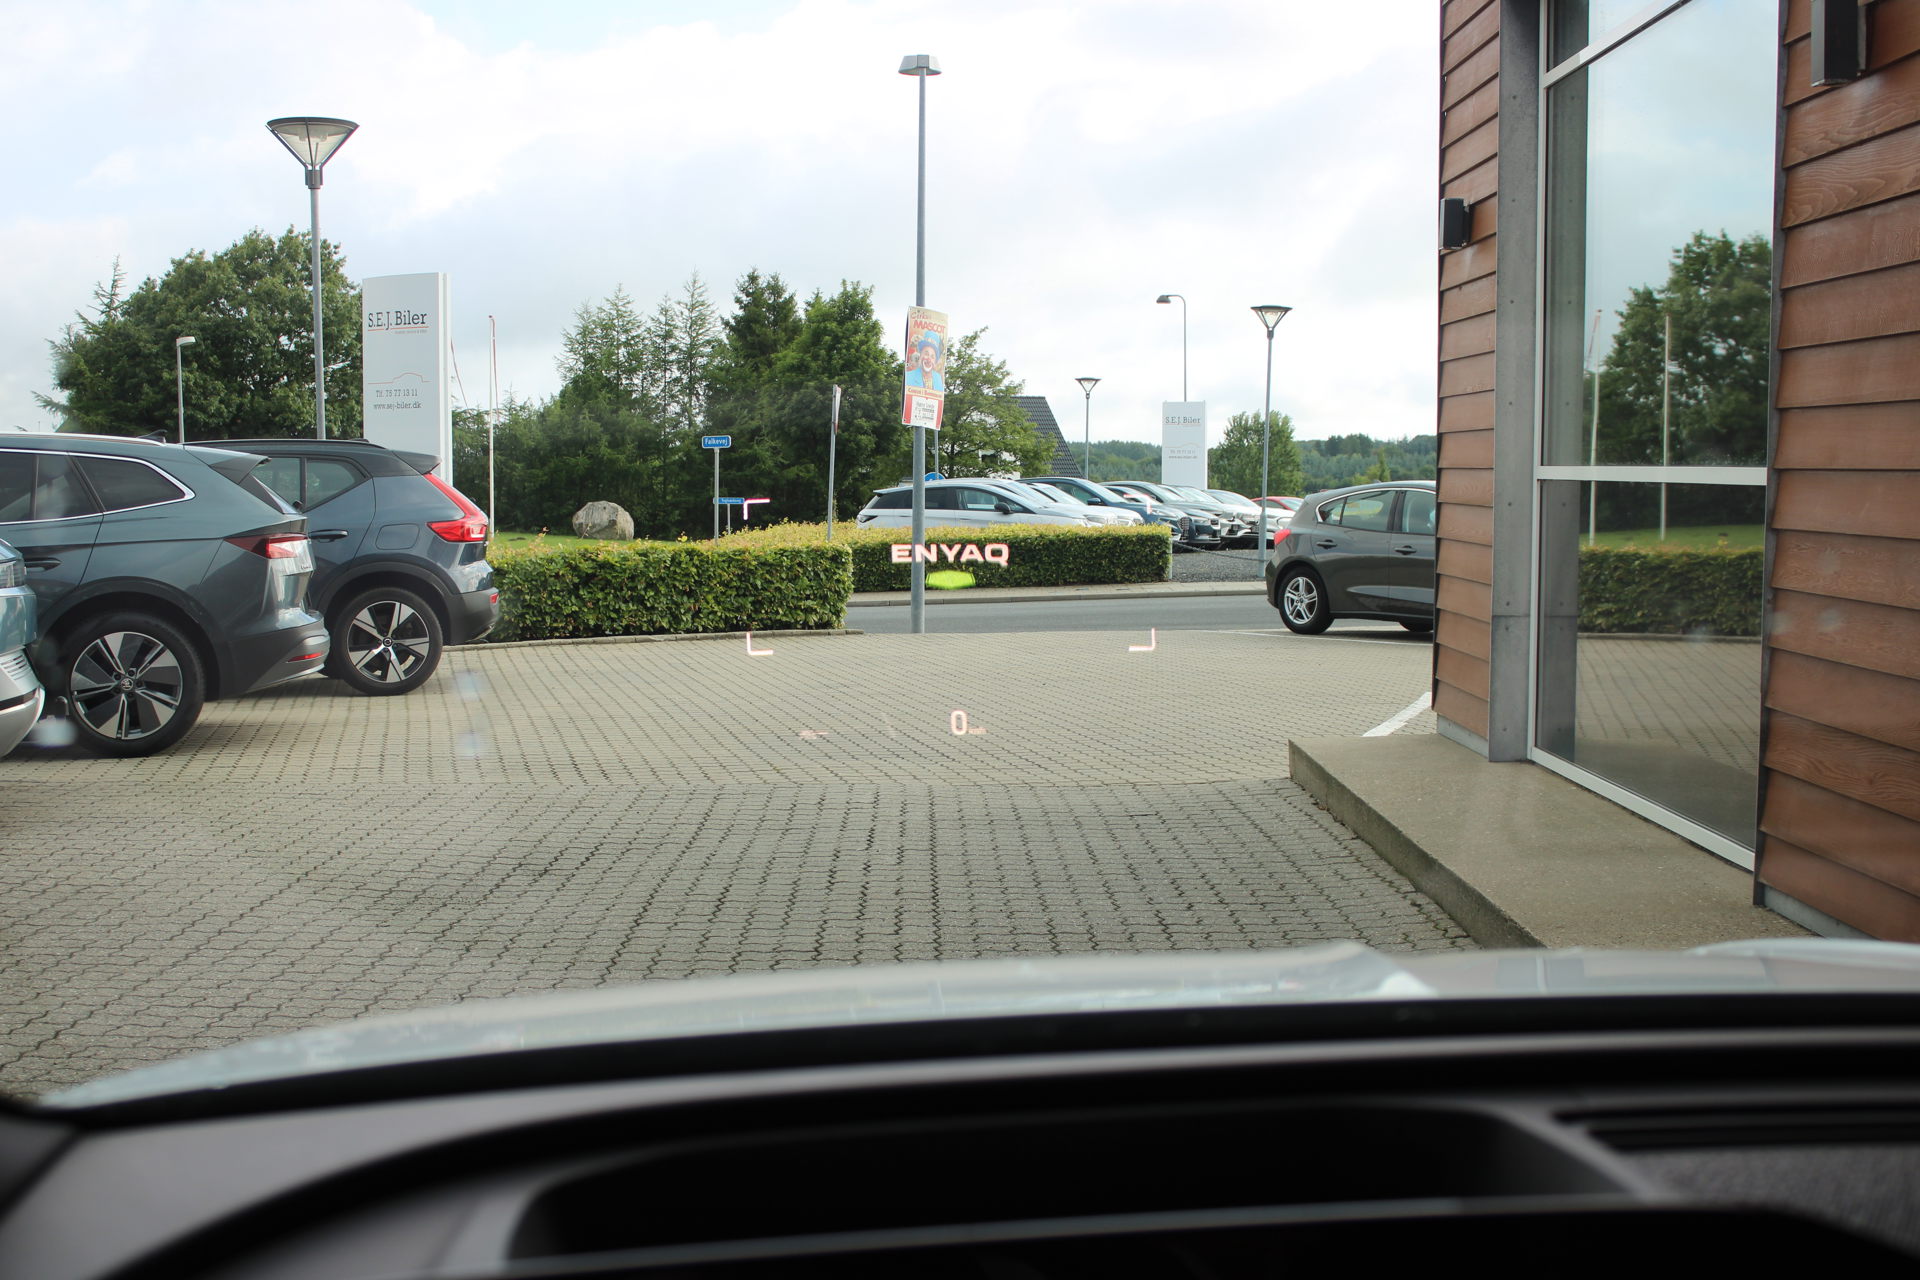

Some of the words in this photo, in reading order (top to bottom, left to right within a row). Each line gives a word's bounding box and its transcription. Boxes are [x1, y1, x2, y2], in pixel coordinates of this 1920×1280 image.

[368, 311, 392, 331] S.E.J.
[394, 310, 427, 326] Biler
[913, 320, 945, 334] MASCOT
[704, 437, 728, 446] Falkevej
[891, 543, 1010, 566] ENYAQ
[950, 710, 968, 735] 0
